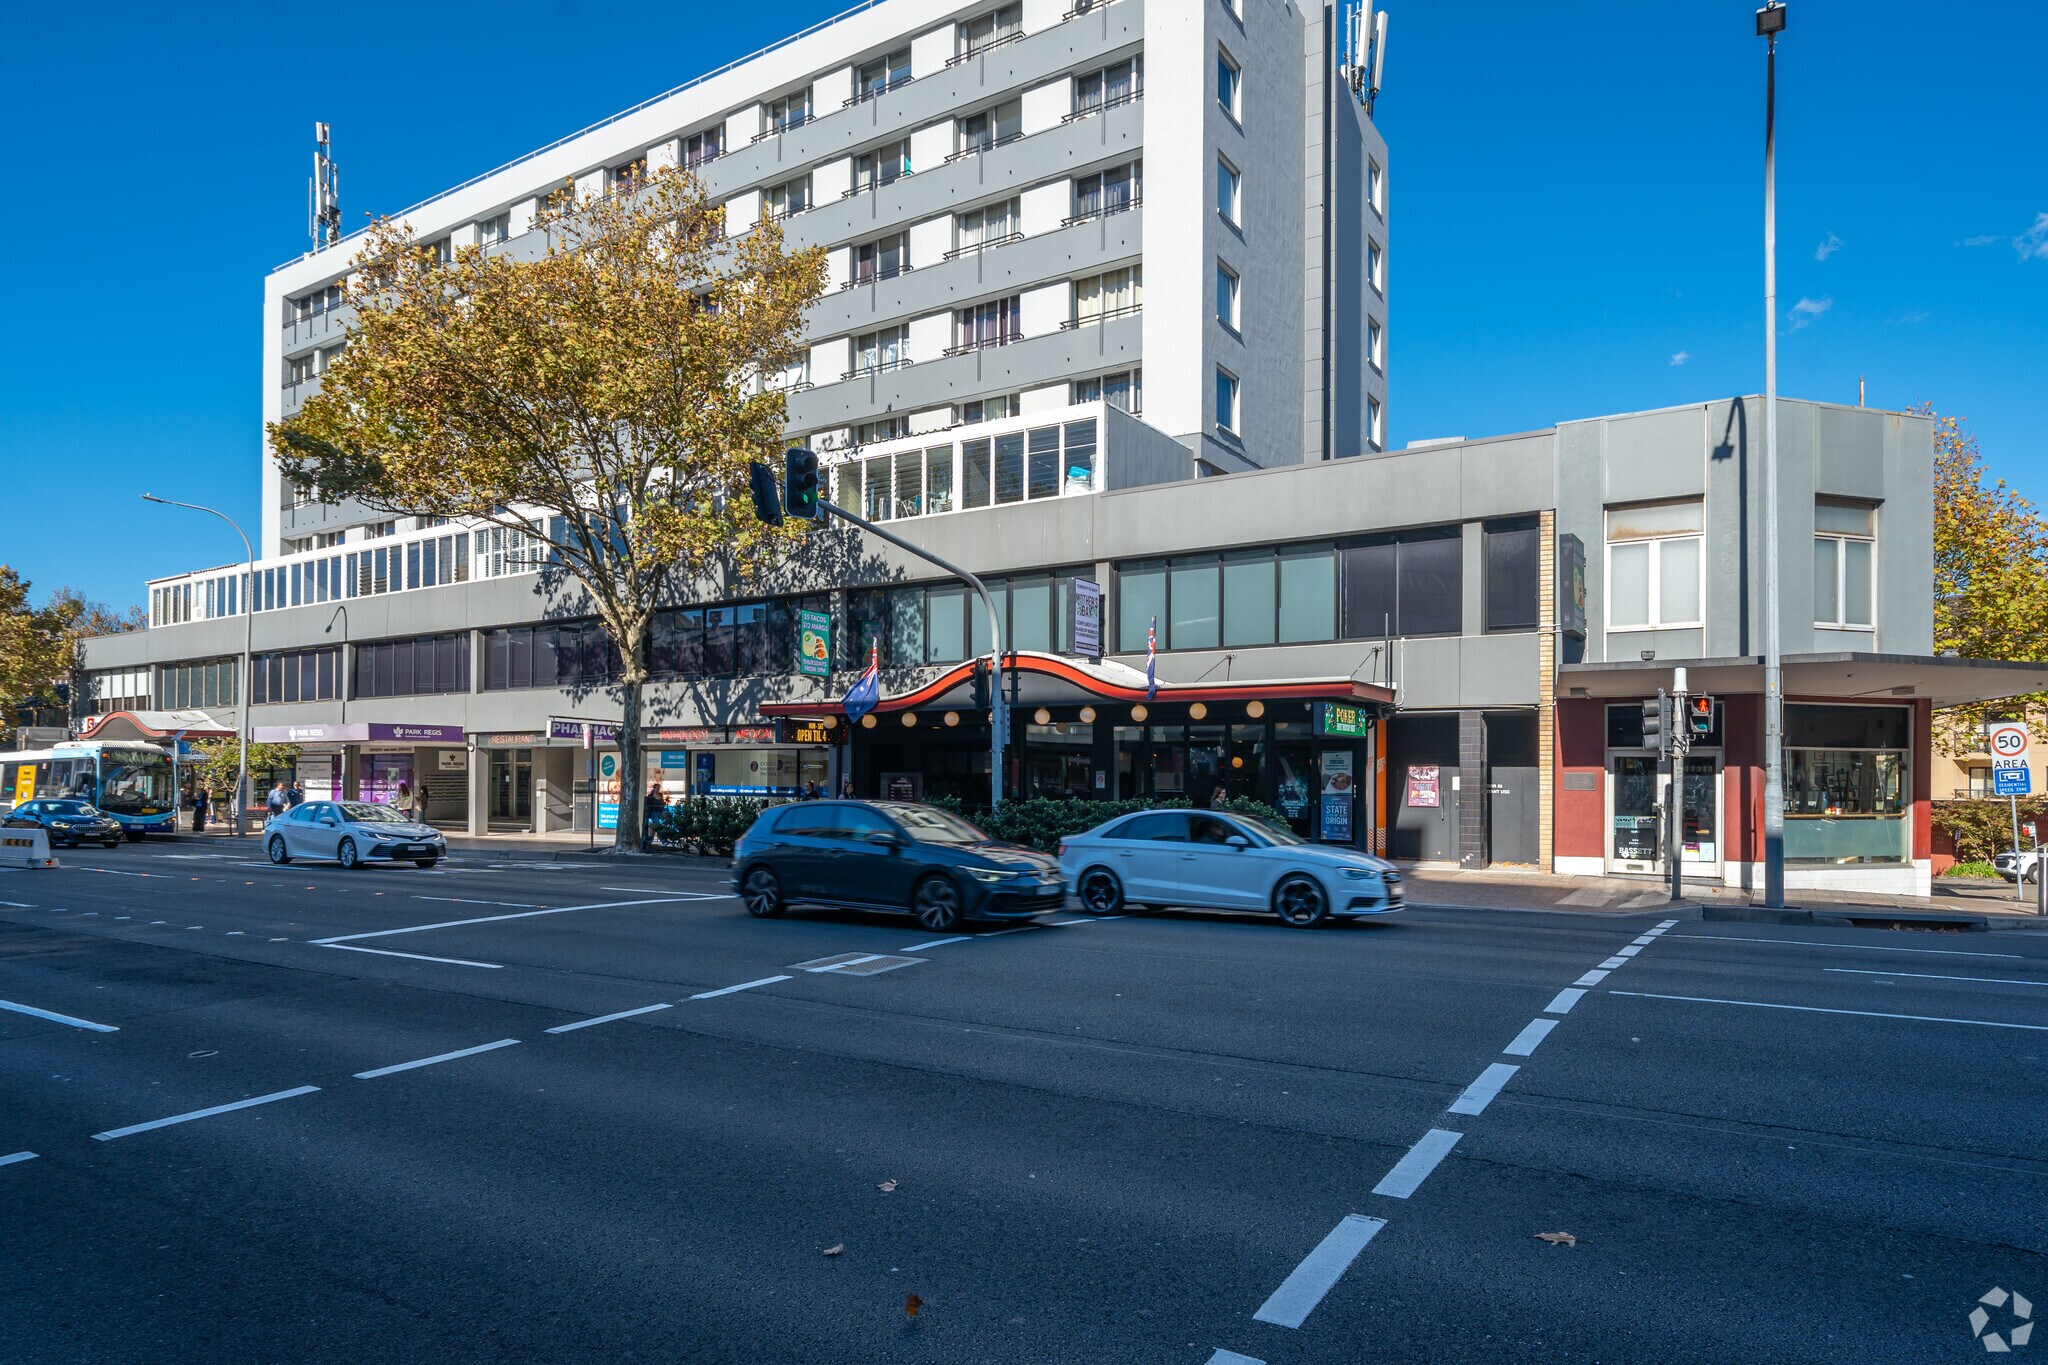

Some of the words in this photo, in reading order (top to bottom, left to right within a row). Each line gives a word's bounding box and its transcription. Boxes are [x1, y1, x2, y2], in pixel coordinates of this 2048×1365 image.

[811, 614, 826, 623] TACOS
[802, 621, 811, 629] $12
[811, 623, 828, 632] MARGS
[803, 659, 827, 667] THURSDAYS
[1336, 707, 1355, 725] POKER
[310, 728, 323, 736] REGIS
[659, 729, 707, 740] PATHOLOGY
[736, 729, 774, 739] MEDICAL
[797, 730, 812, 741] OPEN
[813, 730, 822, 741] TIL
[822, 731, 827, 741] 4
[491, 735, 533, 744] RESTAURANT
[1998, 735, 2021, 749] 50
[1994, 759, 2028, 769] AREA
[1325, 805, 1348, 814] STATE
[1325, 816, 1348, 825] ORIGIN
[1618, 847, 1652, 855] BASSETT
